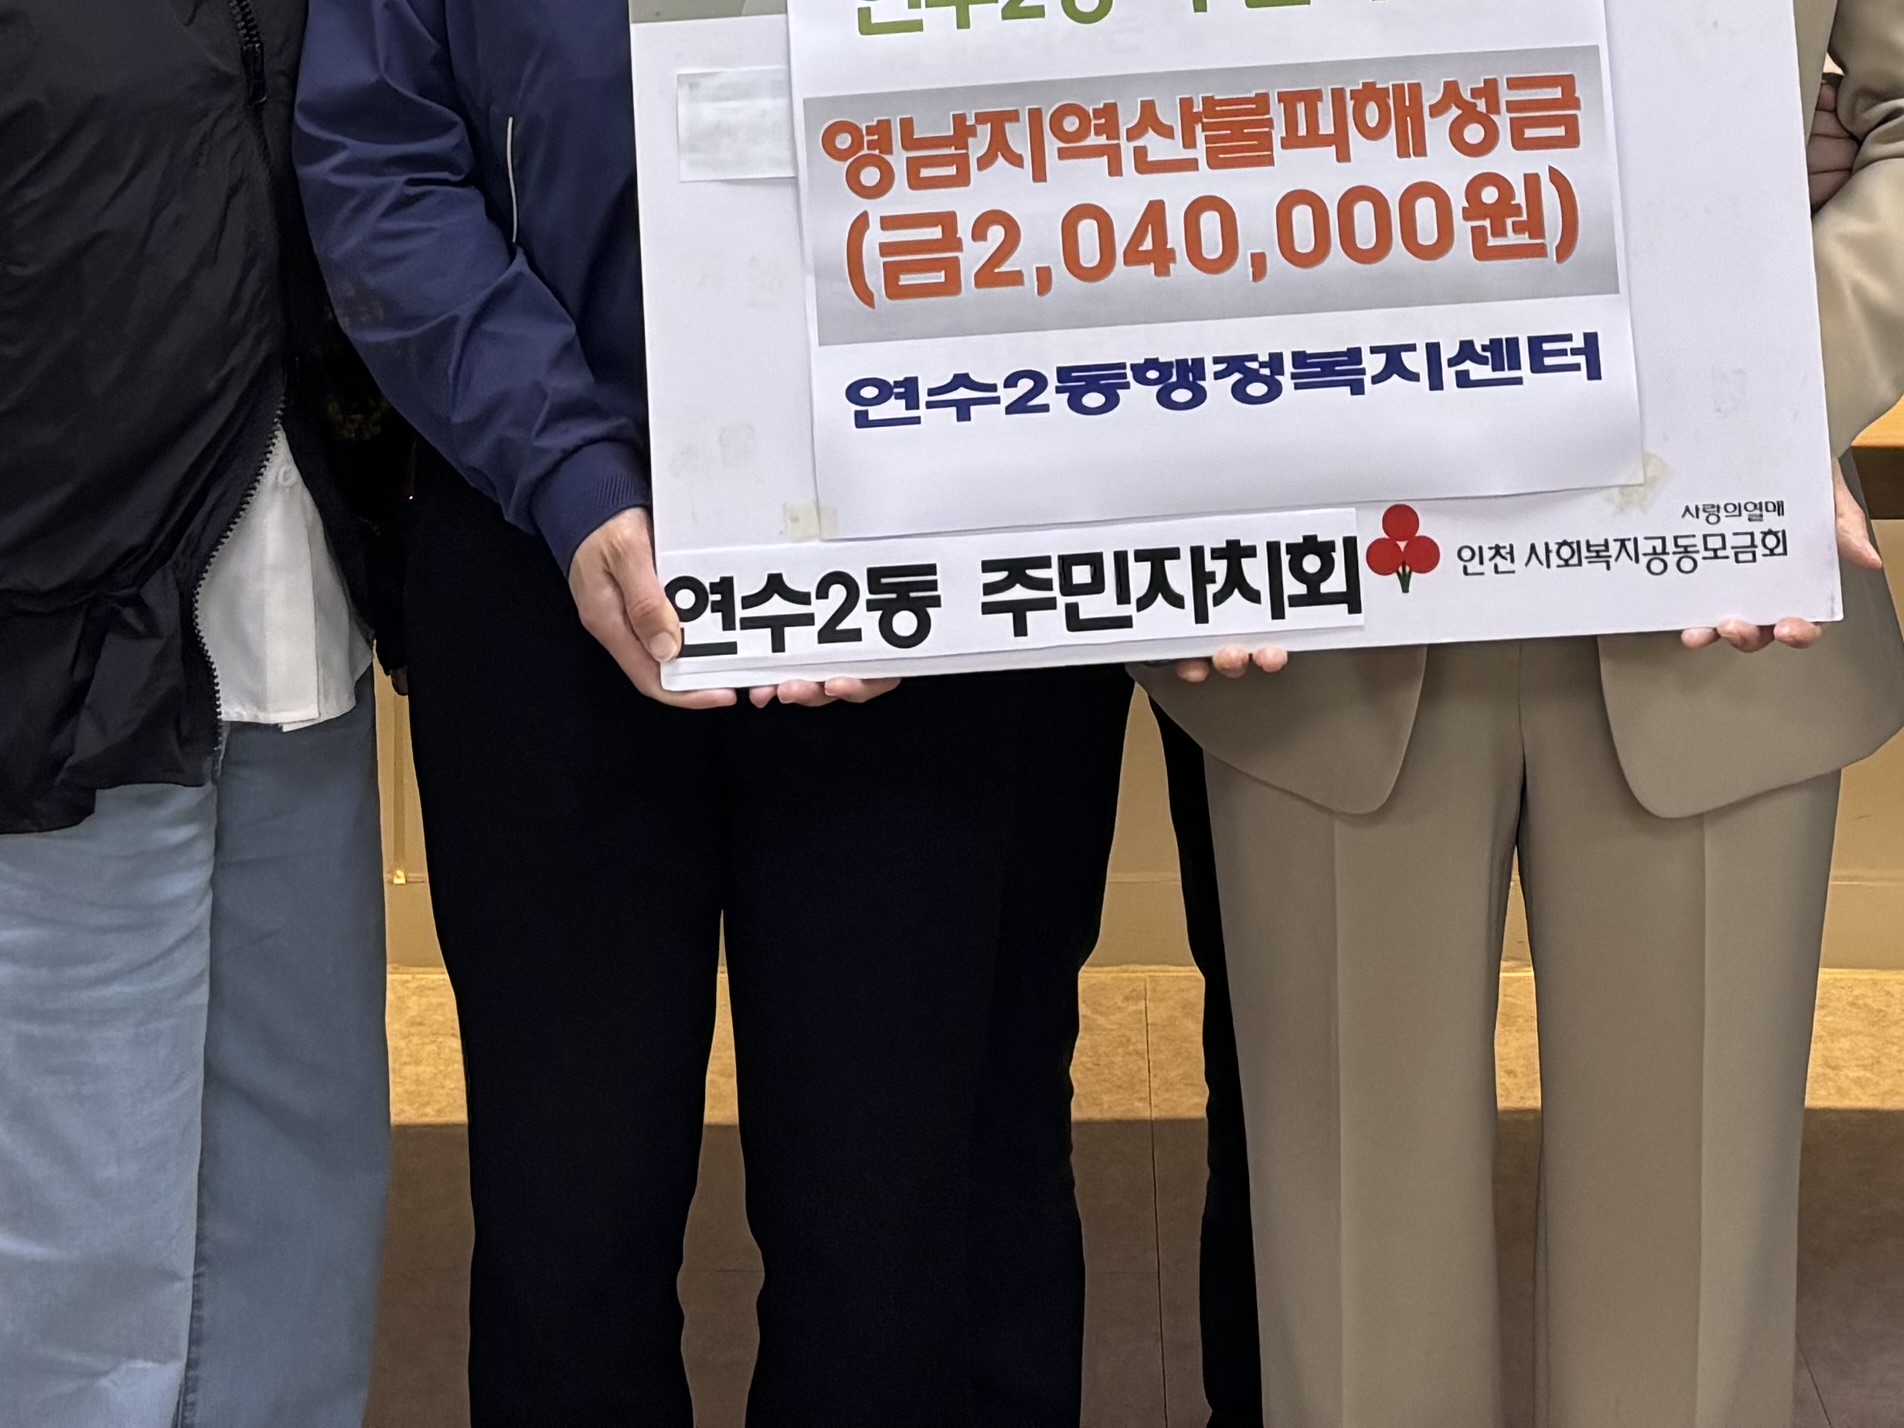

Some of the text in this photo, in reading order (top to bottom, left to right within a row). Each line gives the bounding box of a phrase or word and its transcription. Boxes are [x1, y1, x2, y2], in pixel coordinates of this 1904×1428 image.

[820, 74, 1582, 198] 영남지역산불피해성금
[843, 165, 1580, 310] (금2,040,000원)
[843, 330, 1603, 430] 연수2동행정복지센터
[1456, 528, 1789, 577] 인천 사회복지공동모금회
[1681, 500, 1785, 526] 사랑의열매
[665, 533, 1364, 658] 연수2동 주민자치회
